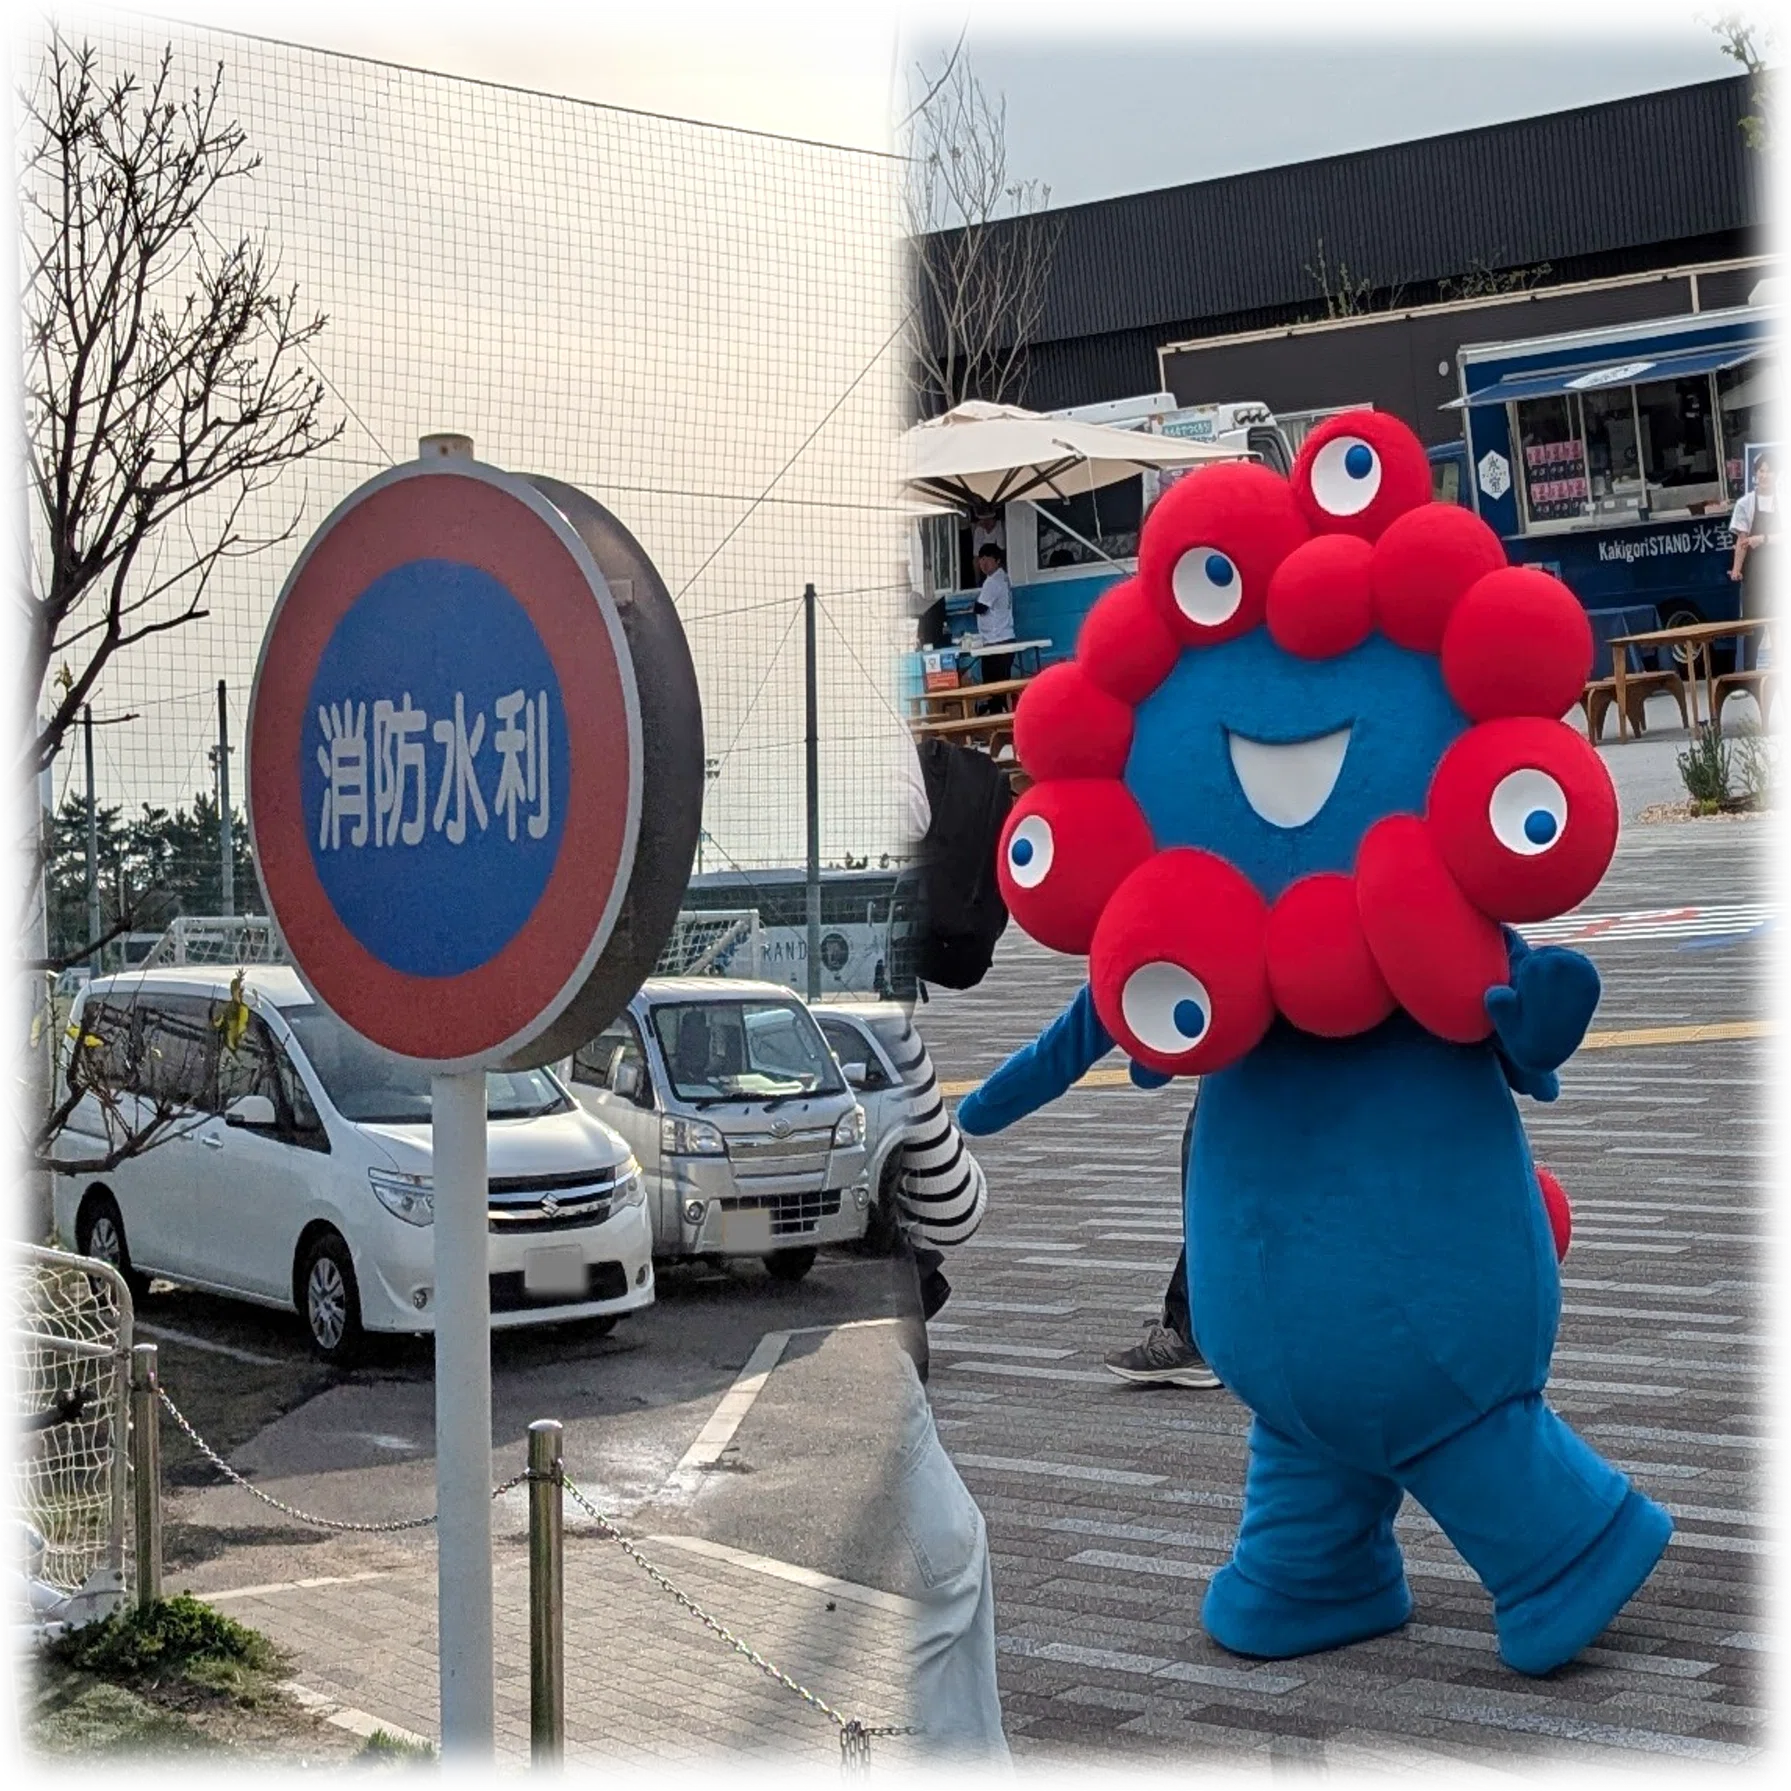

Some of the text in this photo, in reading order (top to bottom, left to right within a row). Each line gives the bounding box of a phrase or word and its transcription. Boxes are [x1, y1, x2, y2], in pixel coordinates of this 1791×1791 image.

[1598, 522, 1735, 562] KakigoriSTAND 氷室
[317, 689, 549, 850] 消防水利
